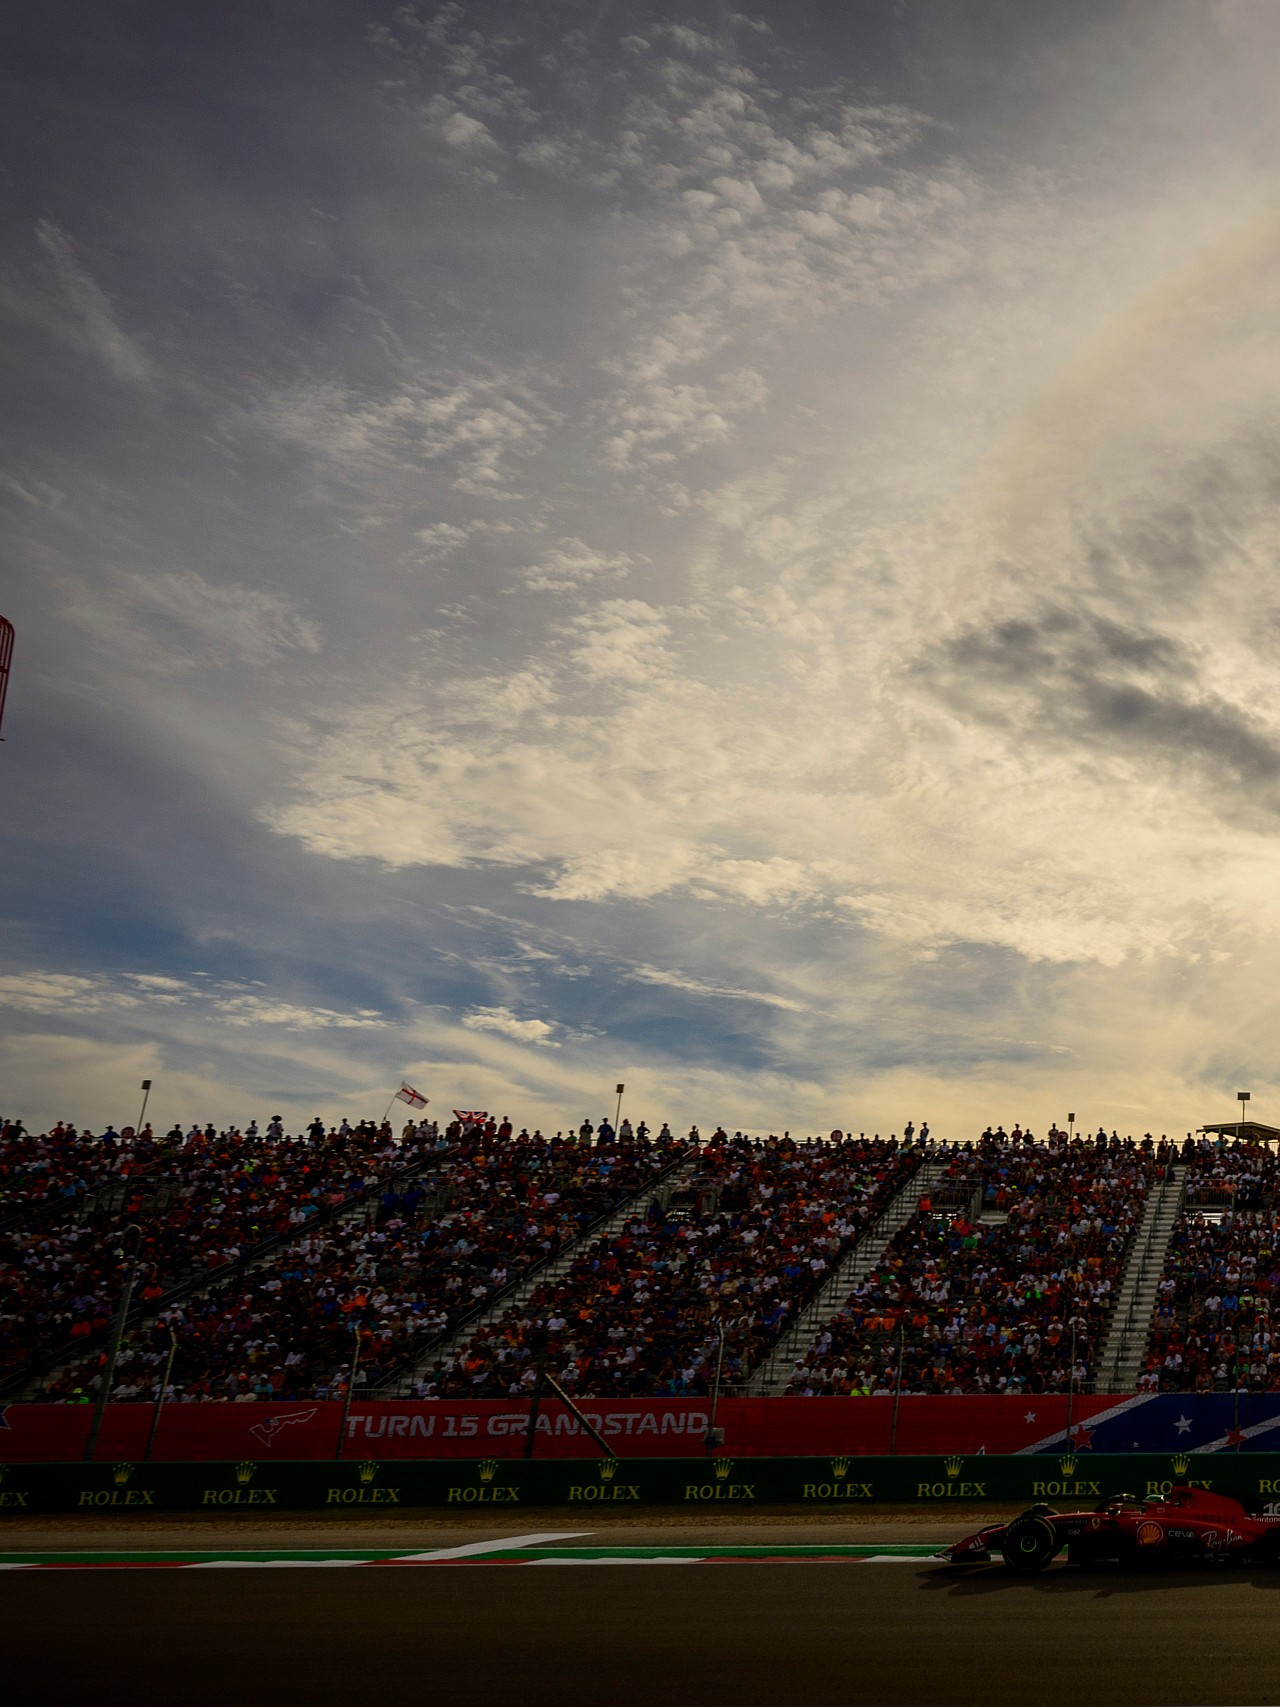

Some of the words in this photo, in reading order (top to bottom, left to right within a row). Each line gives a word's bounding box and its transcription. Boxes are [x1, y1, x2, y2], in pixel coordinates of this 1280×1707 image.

[346, 1415, 436, 1438] TURN
[442, 1415, 480, 1437] 15
[487, 1412, 710, 1437] GRANDSTAND
[447, 1487, 520, 1502] ROLEX
[568, 1485, 642, 1501] ROLEX
[684, 1484, 756, 1500] ROLEX
[803, 1483, 873, 1498] ROLEX
[917, 1482, 987, 1497] ROLEX
[1033, 1481, 1102, 1496] ROLEX
[1146, 1480, 1214, 1495] ROX
[79, 1490, 155, 1505] ROLEX
[201, 1489, 278, 1505] ROLEX
[327, 1489, 401, 1504] ROLEX
